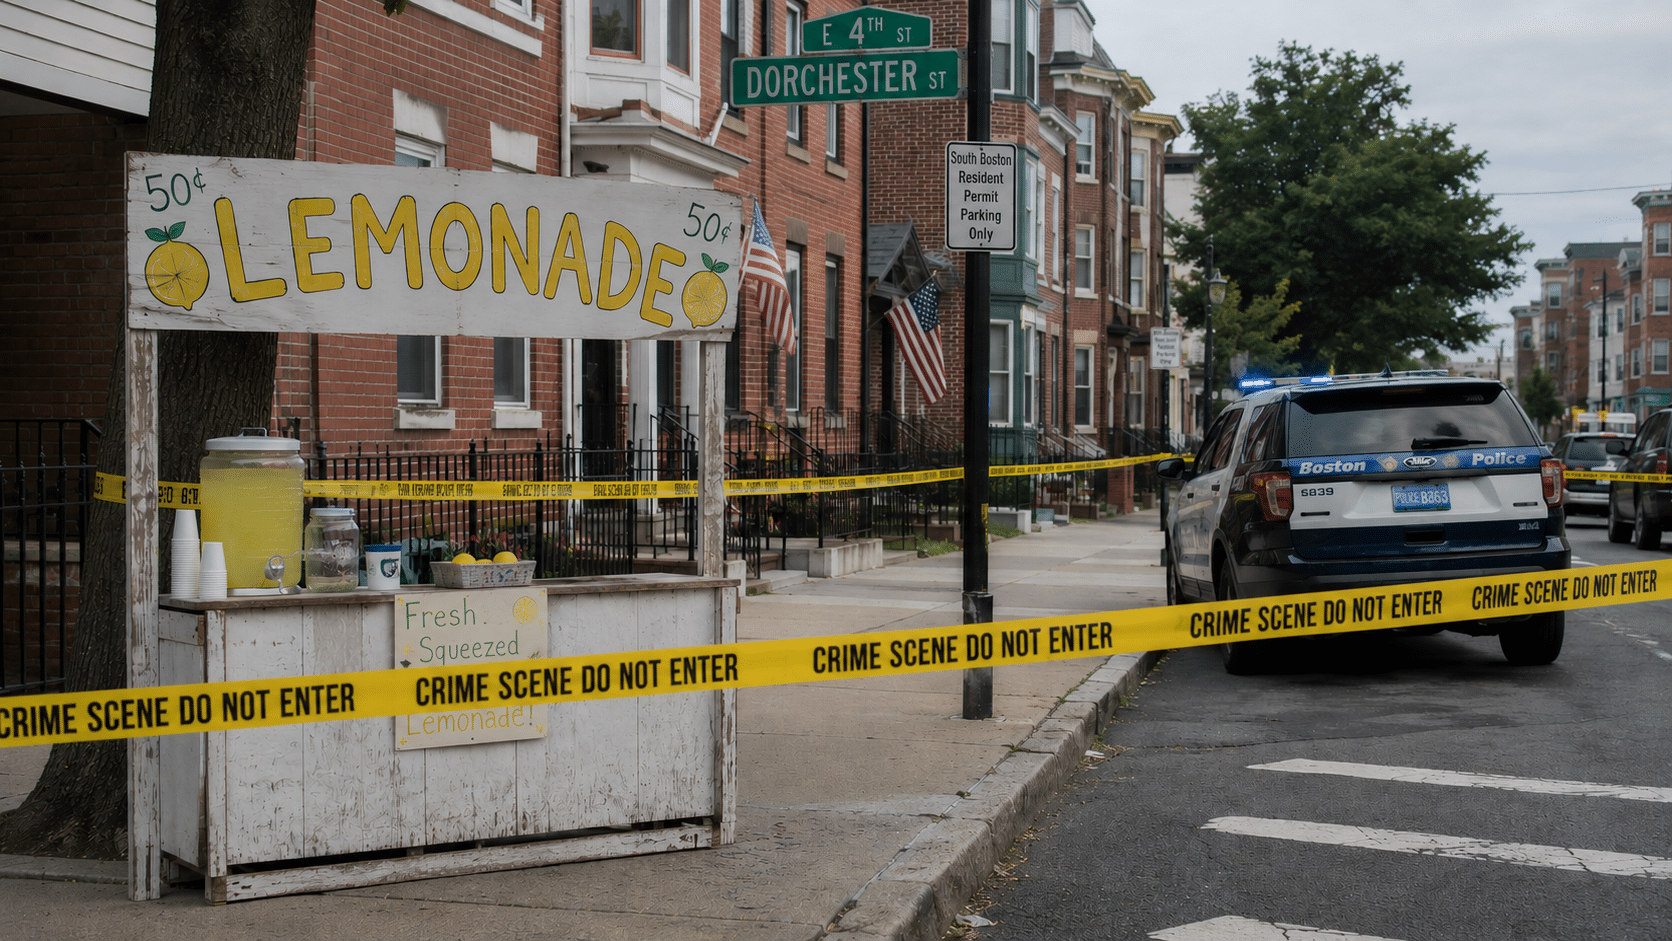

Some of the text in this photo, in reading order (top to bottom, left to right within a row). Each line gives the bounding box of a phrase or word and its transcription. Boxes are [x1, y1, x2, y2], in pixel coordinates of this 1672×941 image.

[823, 17, 912, 46] E 4TH ST
[747, 60, 947, 98] DORCHESTER ST
[950, 150, 1012, 166] South Boston
[145, 167, 207, 213] 50¢
[958, 170, 1004, 184] Resident
[963, 189, 999, 203] Permit
[683, 203, 732, 245] 50¢
[960, 207, 1002, 225] Parking
[968, 226, 994, 243] Only
[213, 194, 688, 328] LEMONADE
[1299, 460, 1367, 475] Boston
[1472, 452, 1527, 466] Police
[1472, 570, 1657, 610] CRIME SCENE DO NOT ENTER
[1191, 590, 1443, 638] CRIME SCENE DO NOT ENTER
[419, 630, 520, 666] Squeezed
[814, 622, 1112, 674] CRIME SCENE DO NOT ENTER
[416, 654, 738, 706] CRIME SCENE DO NOT ENTER
[0, 683, 354, 739] CRIME SCENE DO NOT ENTER
[407, 705, 534, 736] Lemonade!
